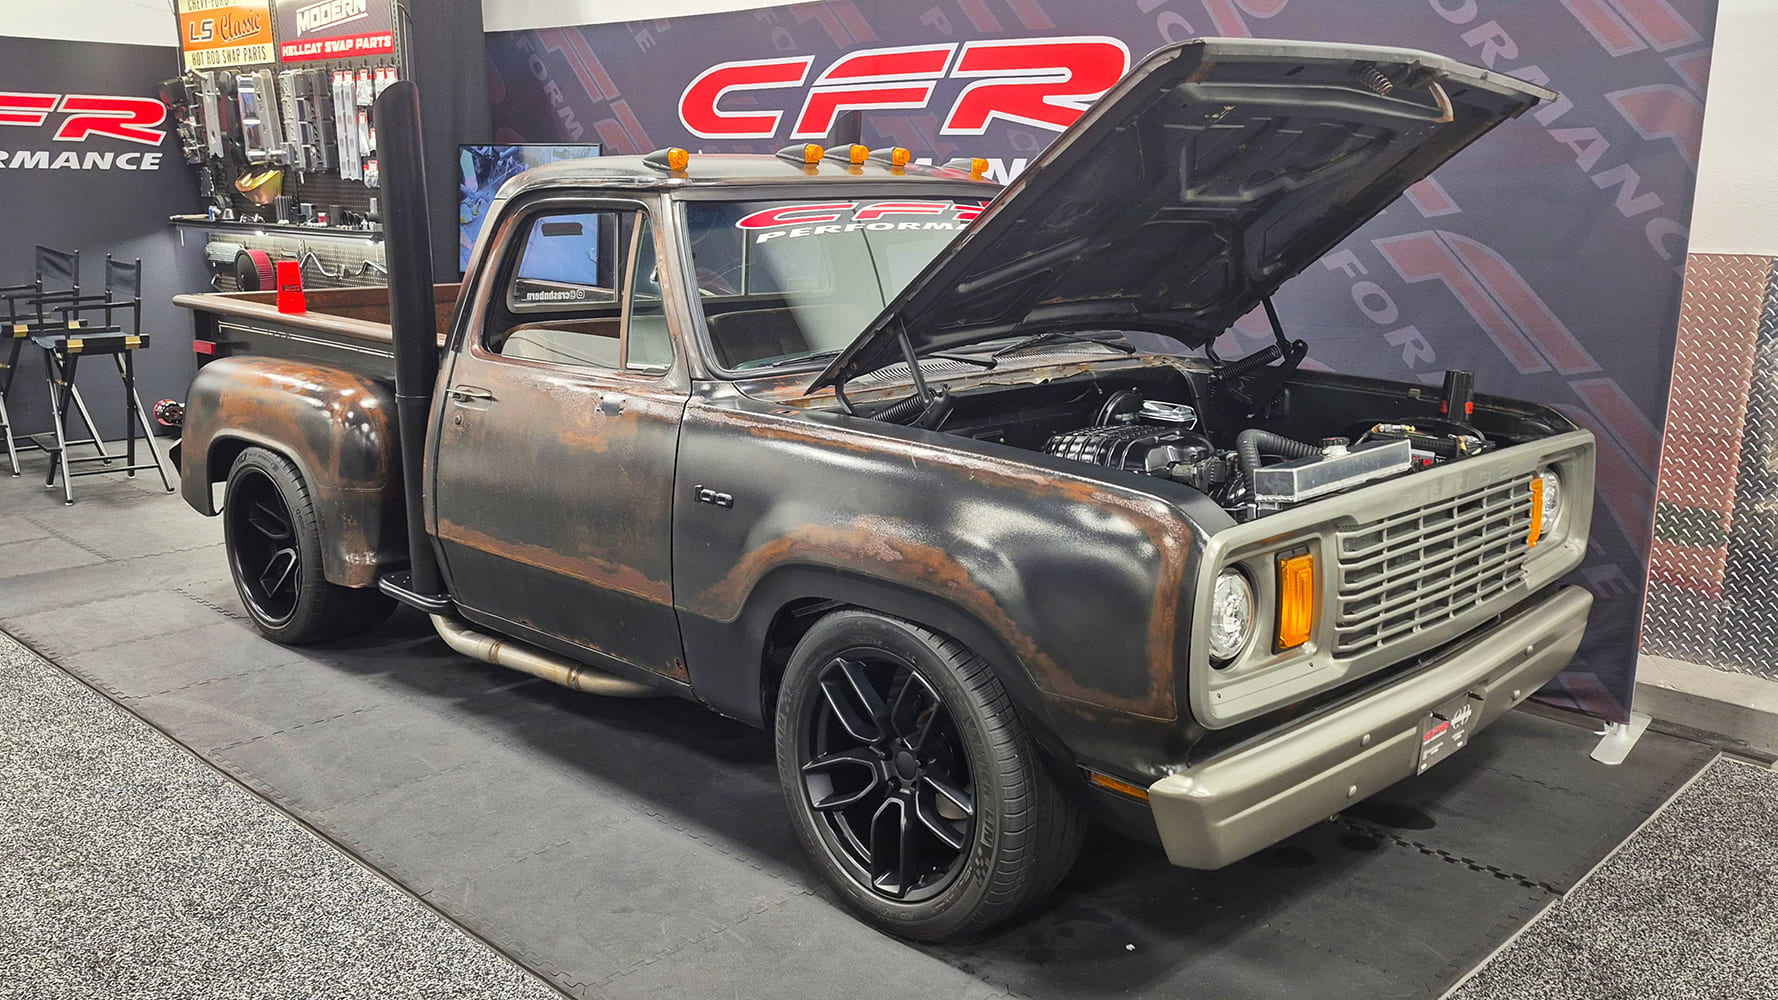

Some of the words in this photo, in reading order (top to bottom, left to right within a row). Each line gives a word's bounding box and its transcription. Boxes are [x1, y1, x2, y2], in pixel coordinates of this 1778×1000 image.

[189, 19, 214, 43] LS
[220, 9, 261, 42] Classic
[296, 0, 367, 38] MODERN
[192, 51, 204, 66] HOT
[206, 50, 220, 65] ROD
[222, 48, 240, 63] SWAP
[243, 46, 267, 61] PARTS
[282, 42, 323, 57] HELLCAT
[324, 39, 354, 53] SWAP
[355, 35, 392, 50] PARTS
[678, 36, 1131, 139] CFR
